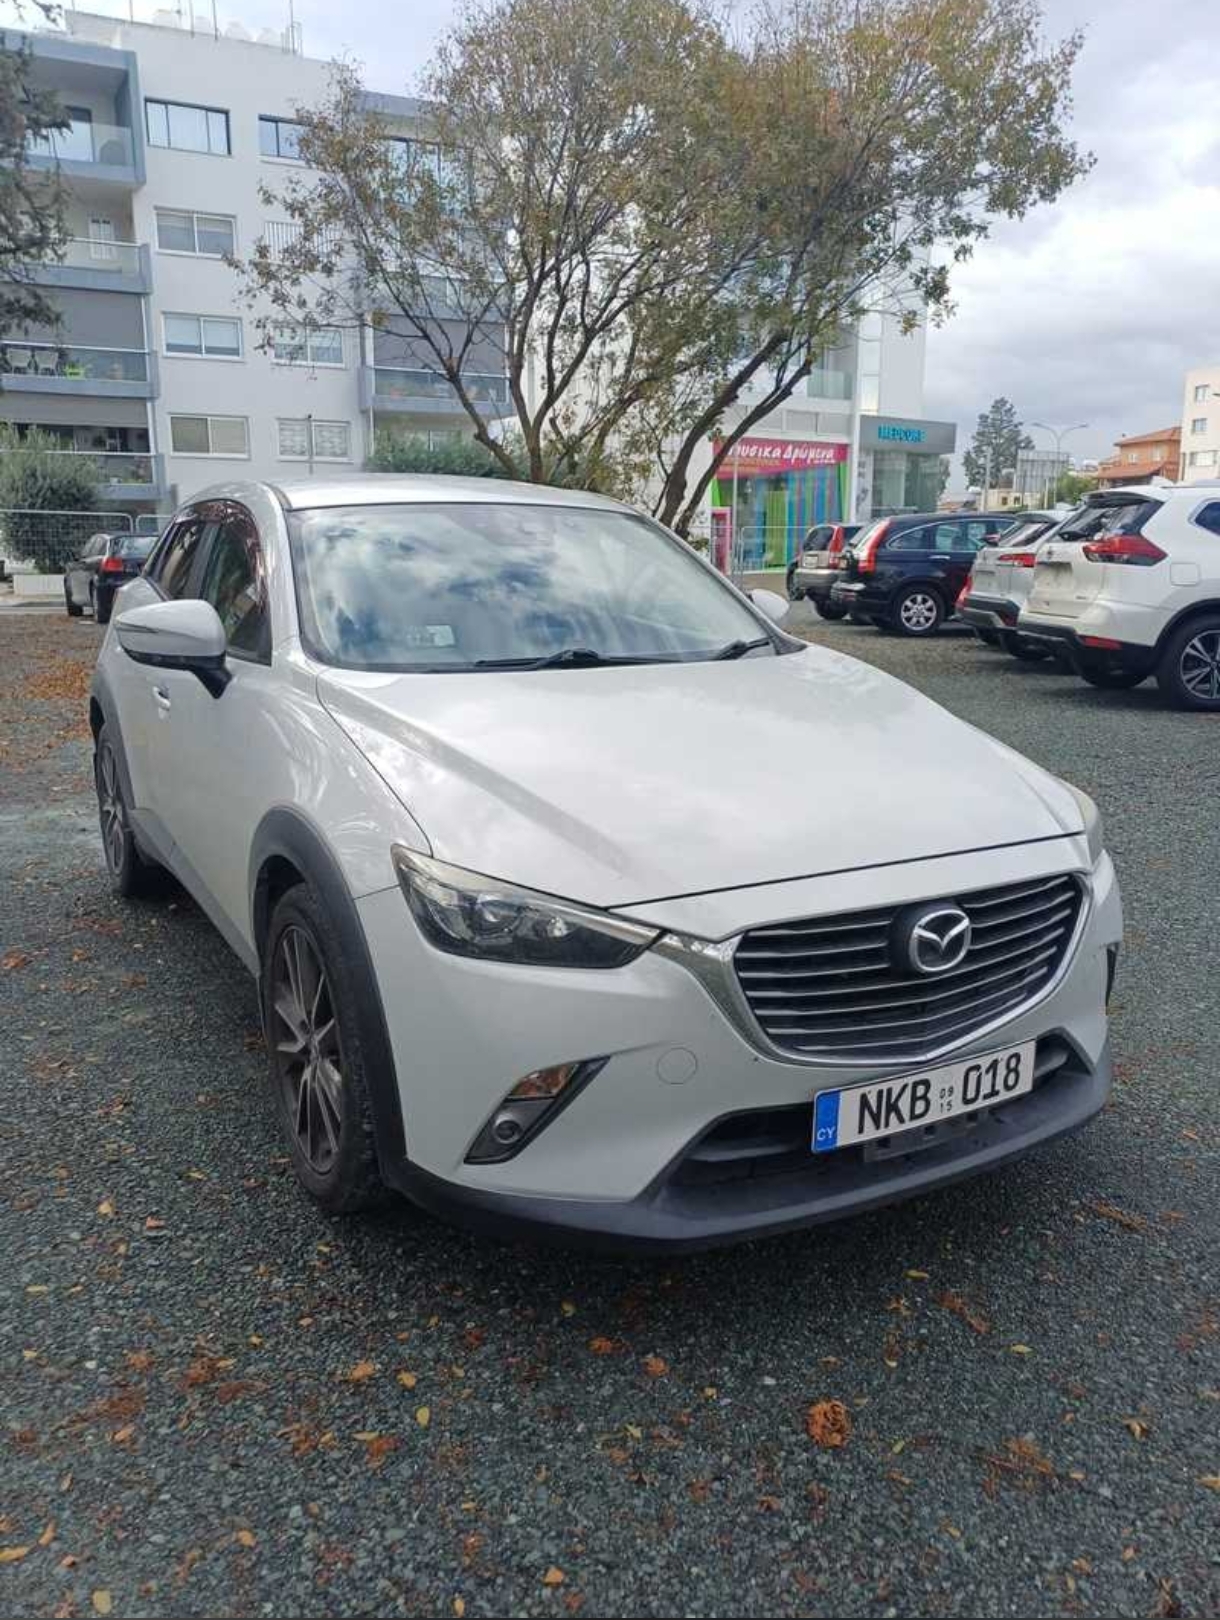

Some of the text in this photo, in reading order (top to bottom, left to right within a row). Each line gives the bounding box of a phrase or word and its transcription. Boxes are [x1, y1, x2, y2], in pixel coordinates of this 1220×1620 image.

[858, 1052, 1021, 1135] NKB 018
[817, 1127, 836, 1140] CY
